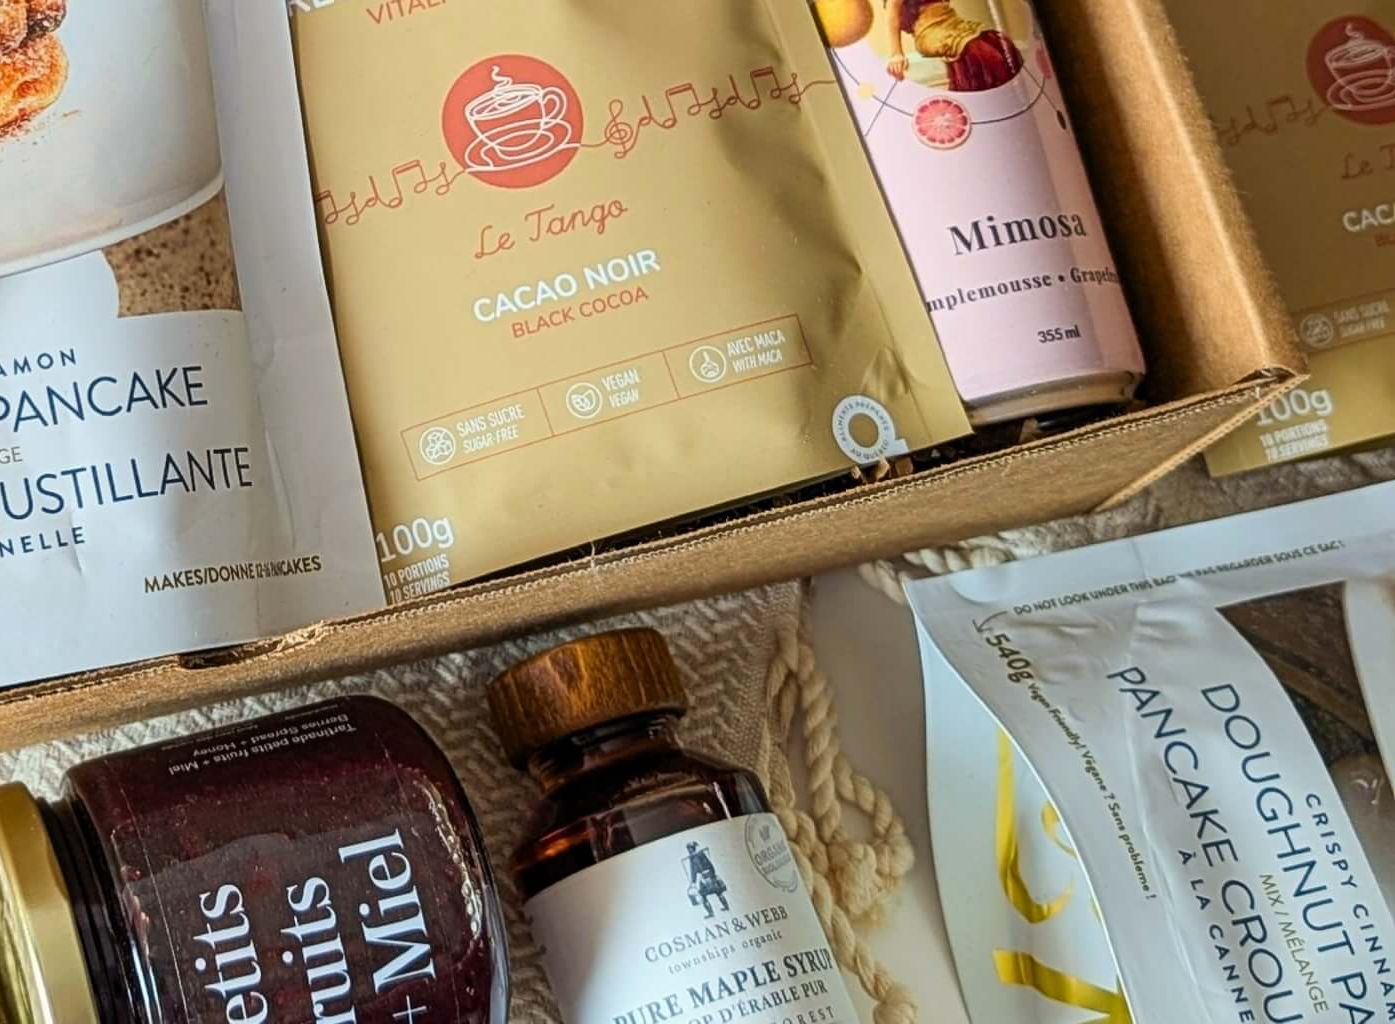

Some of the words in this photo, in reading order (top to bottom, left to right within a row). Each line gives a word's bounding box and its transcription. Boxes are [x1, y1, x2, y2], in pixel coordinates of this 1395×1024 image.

[474, 225, 516, 259] Le
[524, 199, 628, 242] Tango
[948, 214, 1087, 255] Mimosa
[473, 273, 578, 322] CACAO
[583, 249, 662, 289] NOIR
[511, 307, 575, 339] BLACK
[579, 286, 649, 318] COCOA
[727, 335, 754, 356] AVEC
[755, 329, 786, 349] MACA
[1038, 328, 1063, 343] 355
[1065, 325, 1081, 338] ml
[757, 349, 783, 368] MACA
[602, 368, 640, 392] VEGAN
[609, 389, 639, 408] VEGAN
[457, 416, 487, 437] SANS
[488, 404, 525, 427] SUCRE
[376, 517, 454, 563] 100g
[1216, 556, 1273, 573] REGARDER
[1274, 549, 1303, 562] SOUS
[1303, 545, 1317, 556] CE
[144, 563, 255, 594] MAKES/DONNE
[398, 553, 450, 582] PORTIONS
[1014, 606, 1032, 615] DO
[1034, 600, 1057, 611] NOT
[1058, 594, 1089, 605] LOOK
[1090, 586, 1128, 600] UNDER
[1129, 580, 1153, 591] THIS
[252, 737, 289, 754] petits
[293, 723, 357, 744] Tartinade
[985, 634, 1035, 683] 540g
[1028, 683, 1050, 709] Vegan
[1108, 802, 1126, 831] Sans
[168, 761, 199, 775] Miel
[213, 748, 250, 763] fruits
[1106, 666, 1239, 868] PANCAKE
[1201, 683, 1356, 957] DOUGHNUT
[1306, 792, 1358, 889] CRISPY
[1178, 849, 1197, 864] À
[1190, 879, 1212, 911] LA
[338, 829, 436, 994] Miel
[194, 884, 268, 1024] etits
[668, 943, 736, 975] townships
[742, 929, 783, 949] organic
[1260, 874, 1285, 906] MIX
[1280, 921, 1330, 1013] MÉLANGE
[687, 959, 781, 1008] MAPLE
[783, 948, 834, 978] SYRUP
[801, 979, 828, 998] PUR
